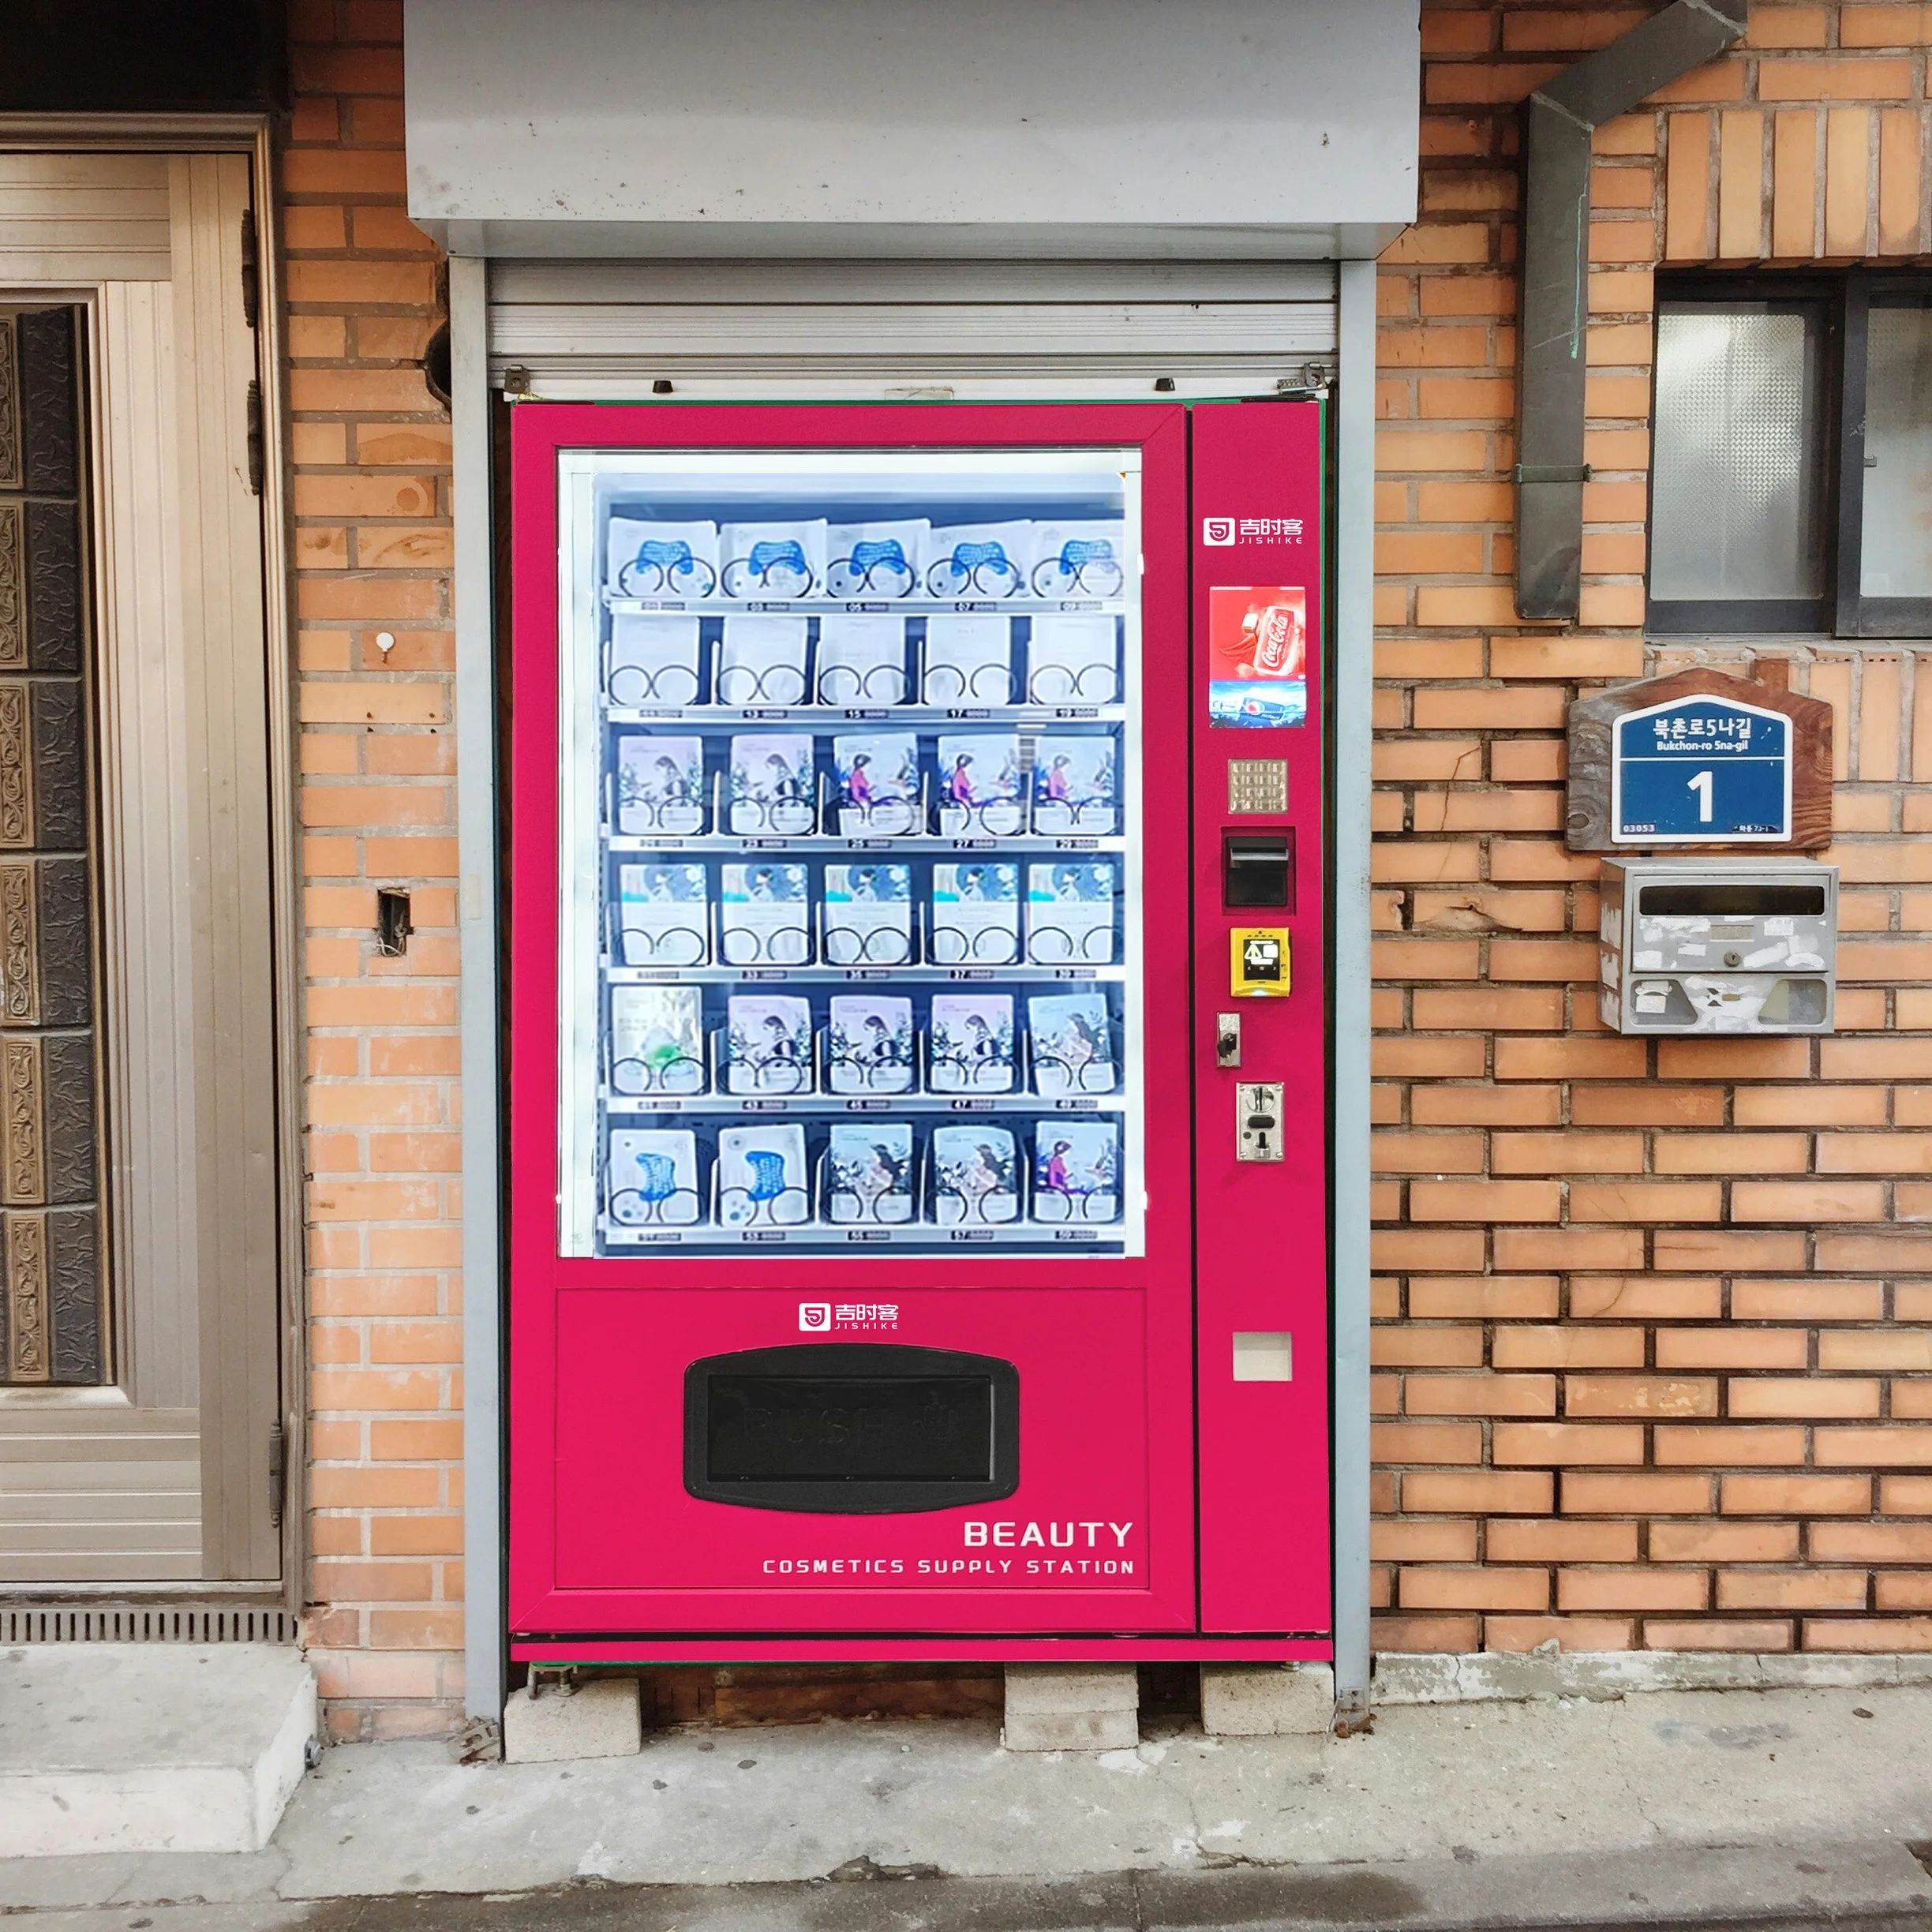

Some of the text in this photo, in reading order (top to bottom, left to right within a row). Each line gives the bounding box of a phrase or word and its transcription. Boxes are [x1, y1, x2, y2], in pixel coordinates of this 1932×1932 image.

[1239, 519, 1304, 536] 吉时客
[1653, 717, 1751, 739] 북촌로5나길
[1657, 739, 1748, 752] Bukchon-ro 5na-gil
[1687, 771, 1713, 822] 1
[1623, 824, 1655, 833] 03053
[835, 1304, 899, 1321] 吉时客
[964, 1522, 1133, 1548] BEAUTY
[762, 1559, 1134, 1574] COSMETICS SUPPLY STATION
